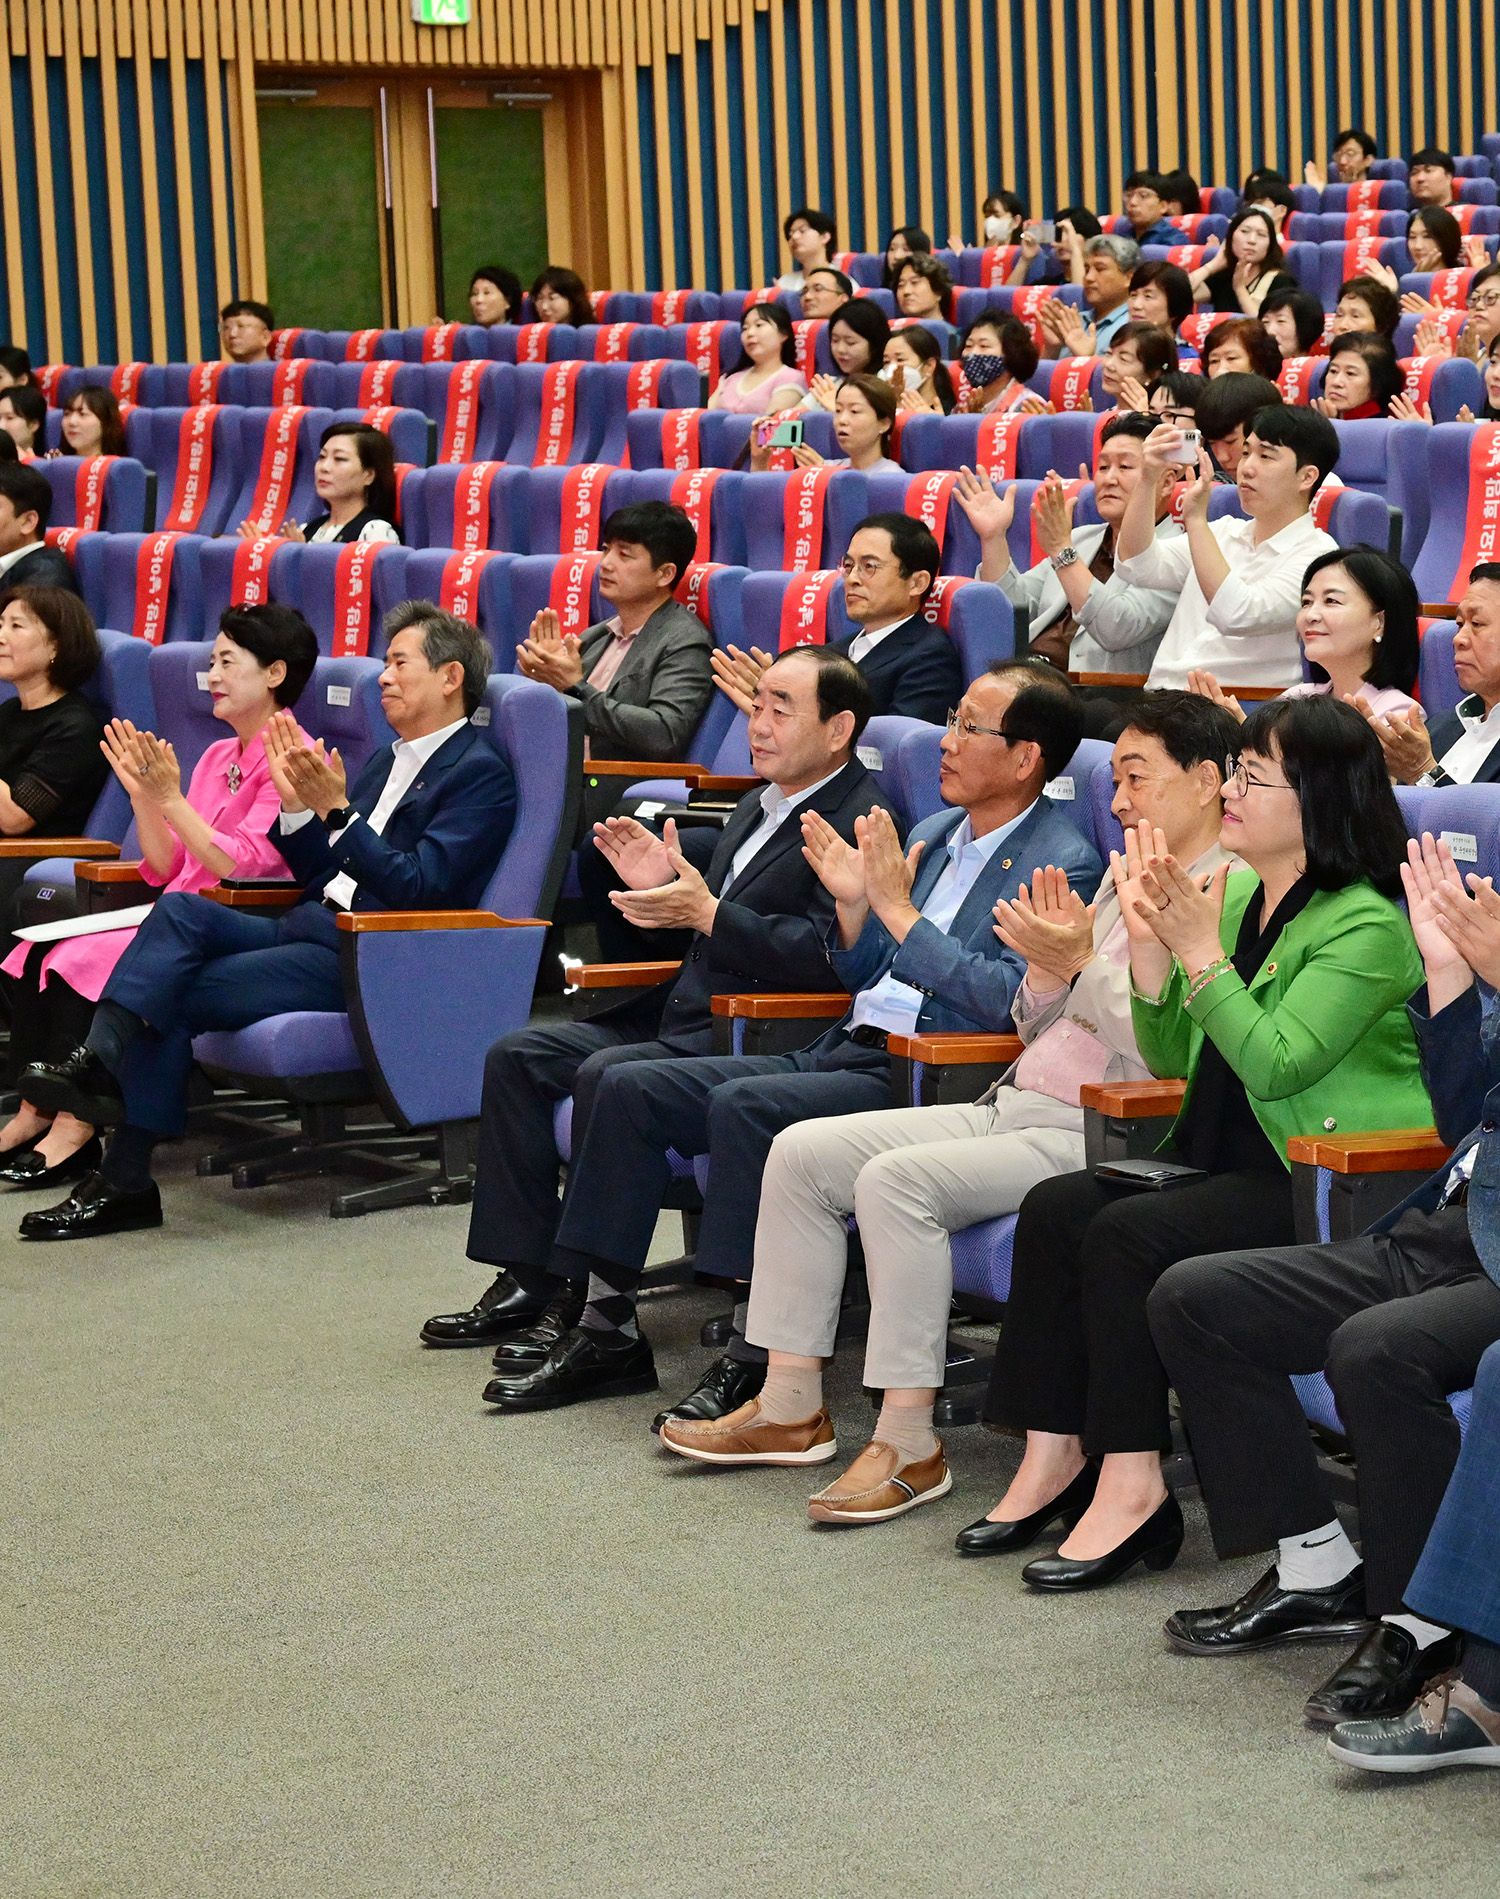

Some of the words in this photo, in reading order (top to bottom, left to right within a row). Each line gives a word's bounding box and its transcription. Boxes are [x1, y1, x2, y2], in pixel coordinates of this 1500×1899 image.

[465, 460, 494, 516] 낳아요
[797, 466, 823, 529] 낳아요!
[348, 540, 373, 597] 낳아요
[562, 558, 588, 627] 낳아요!
[686, 567, 707, 614] 아요!
[143, 597, 161, 641] 희망,
[345, 601, 362, 646] 희망,
[797, 569, 833, 628] 낳아요
